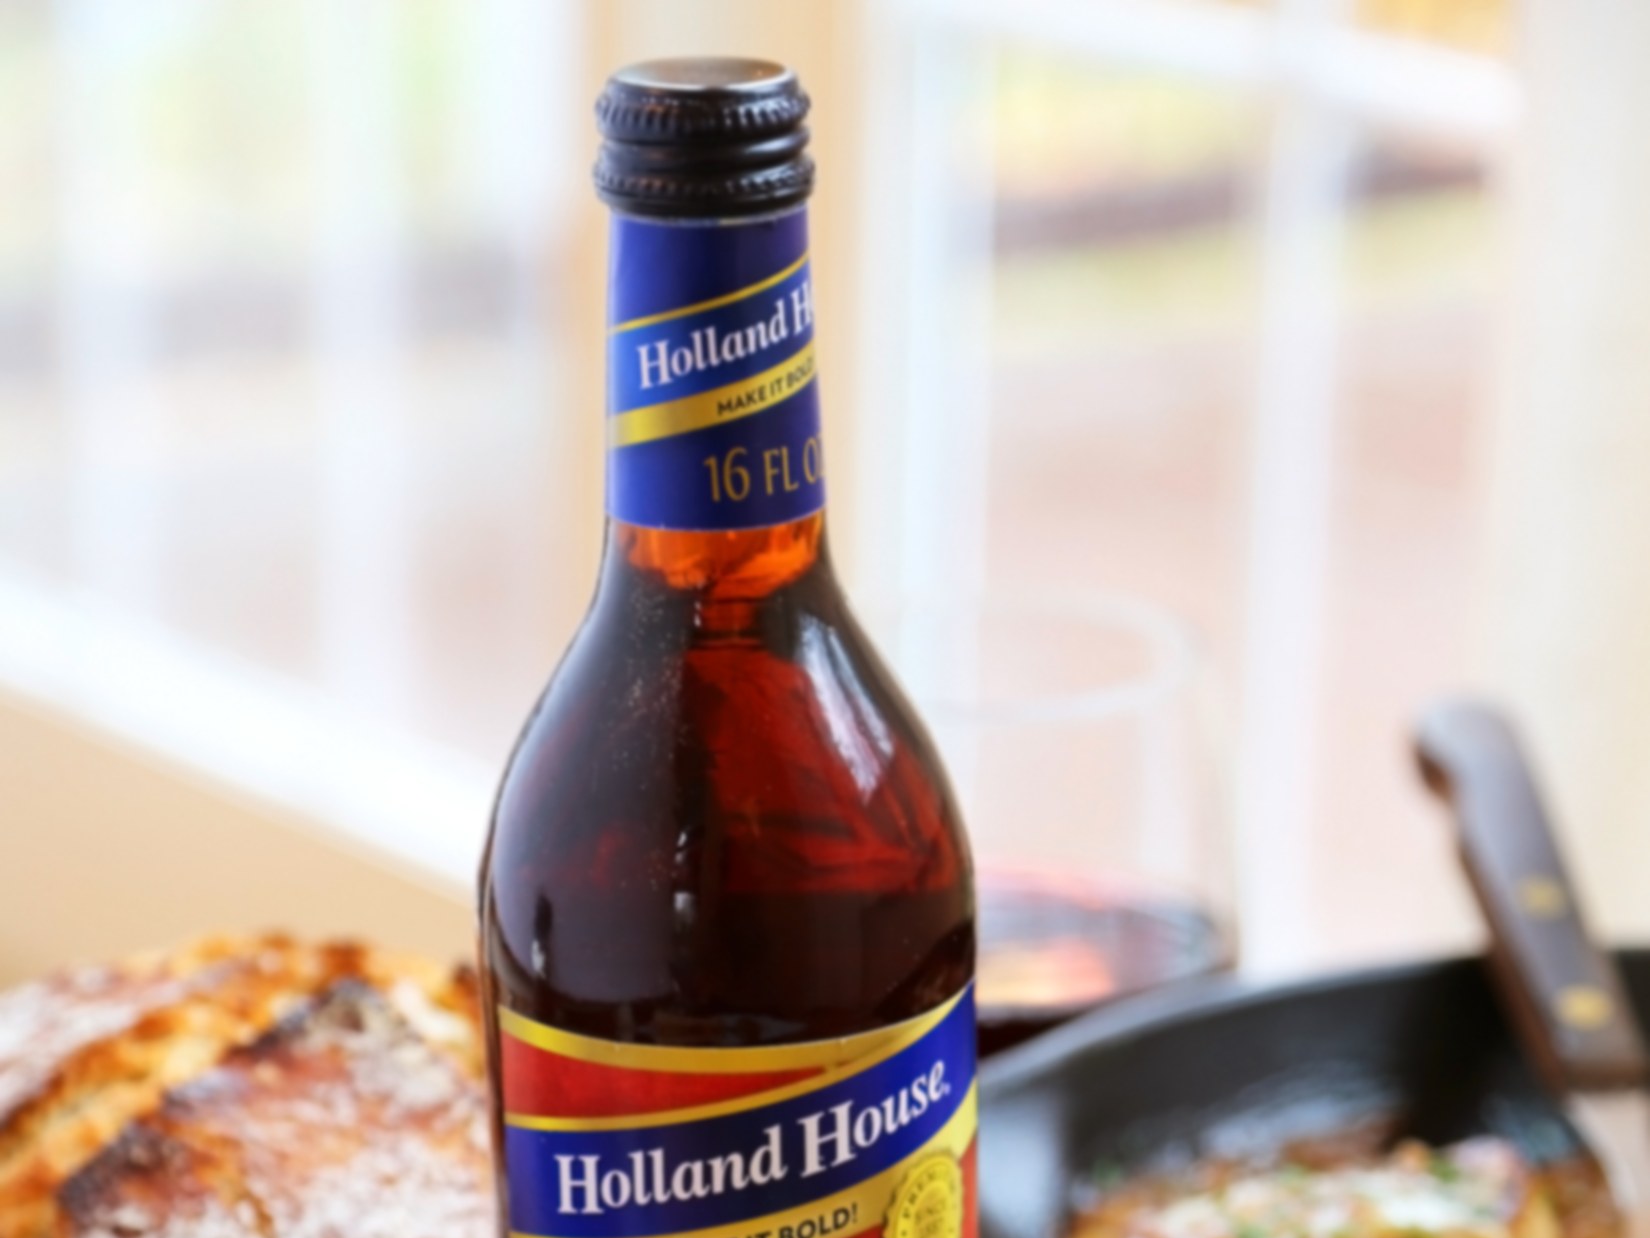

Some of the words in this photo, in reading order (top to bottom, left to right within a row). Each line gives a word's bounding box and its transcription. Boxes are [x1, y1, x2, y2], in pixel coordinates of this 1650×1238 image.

[637, 298, 789, 389] Holland
[717, 385, 766, 416] MAKE
[769, 377, 784, 397] IT
[704, 446, 750, 504] 16
[763, 446, 798, 495] FL
[803, 437, 822, 485] O
[554, 1124, 788, 1214] Holland
